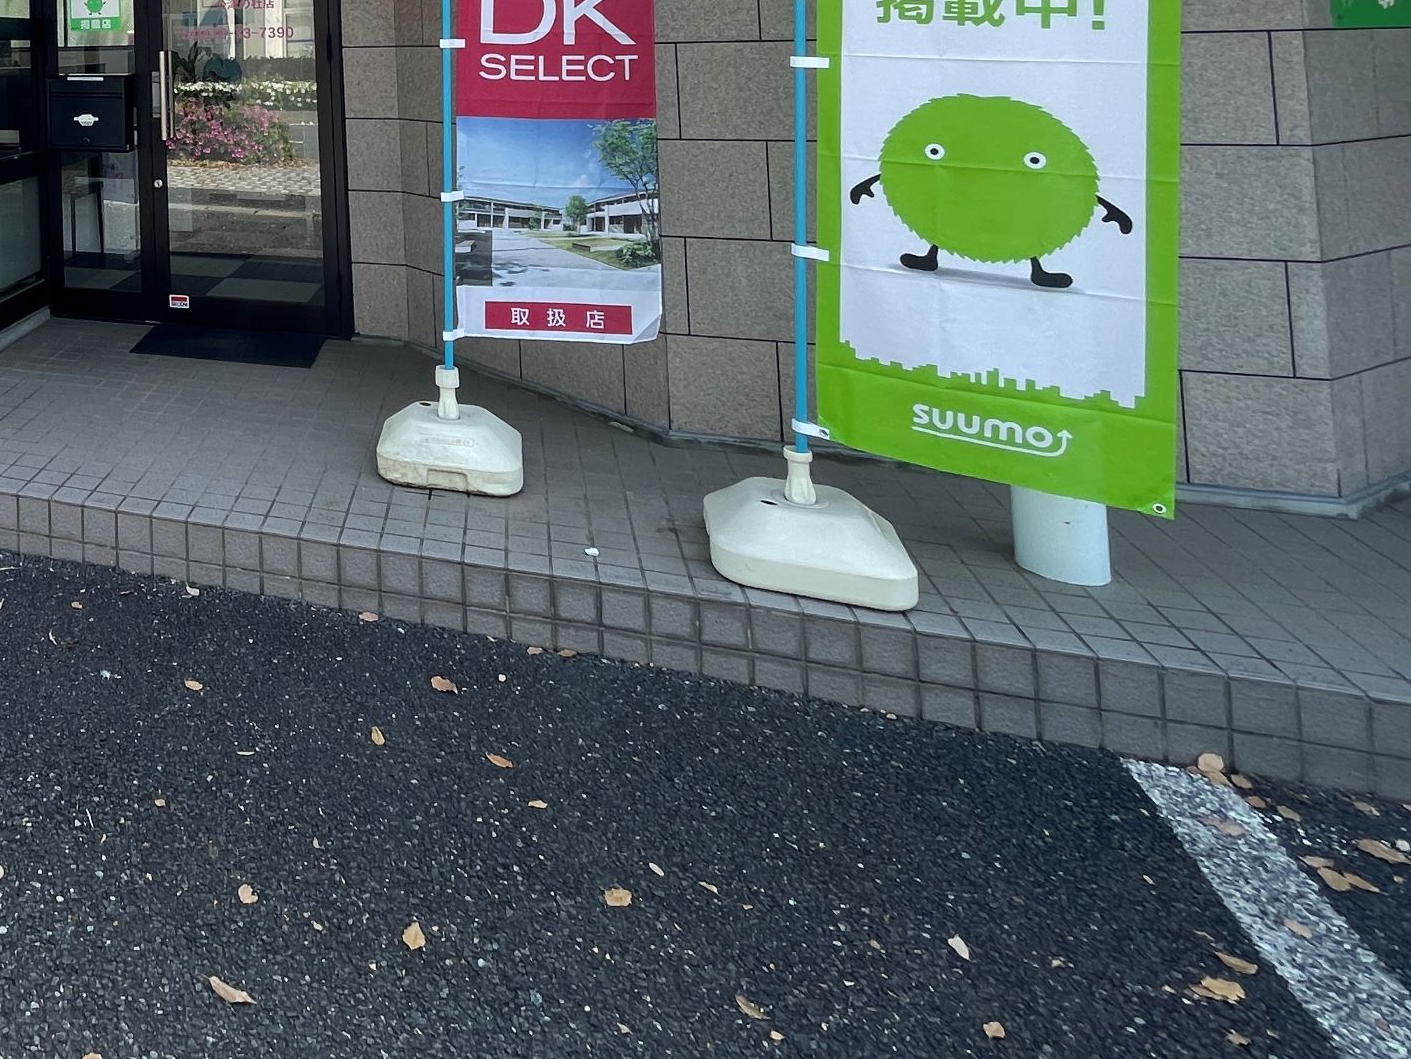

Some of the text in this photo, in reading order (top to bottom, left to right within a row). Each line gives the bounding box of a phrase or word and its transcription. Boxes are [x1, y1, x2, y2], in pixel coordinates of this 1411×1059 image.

[478, 53, 639, 82] SELECT
[510, 307, 606, 330] 取扱店
[912, 403, 1054, 449] suumo
